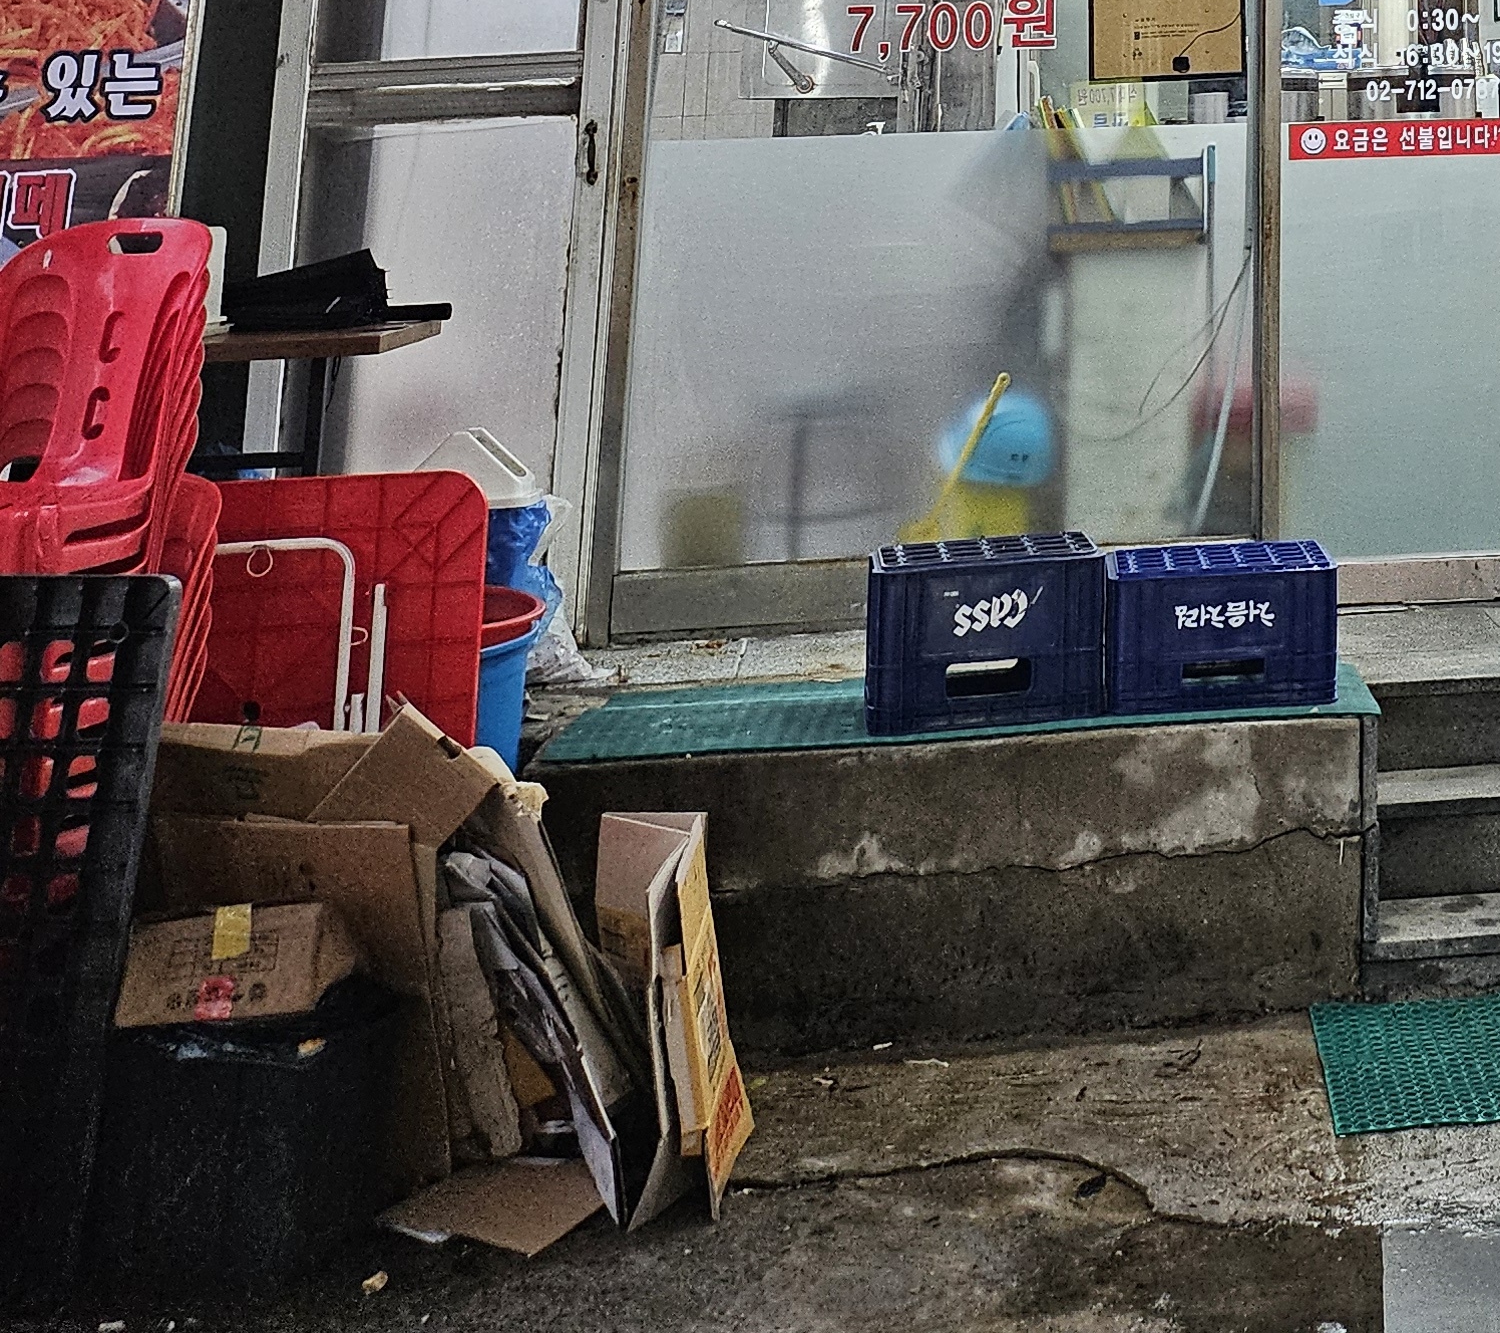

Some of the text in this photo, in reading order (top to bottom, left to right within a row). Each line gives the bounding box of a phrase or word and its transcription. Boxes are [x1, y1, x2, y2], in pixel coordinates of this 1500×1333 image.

[43, 51, 160, 120] 있는
[1366, 79, 1500, 102] 02-712-0787
[1332, 127, 1389, 153] 요금은
[1173, 599, 1276, 630] 처음처럼
